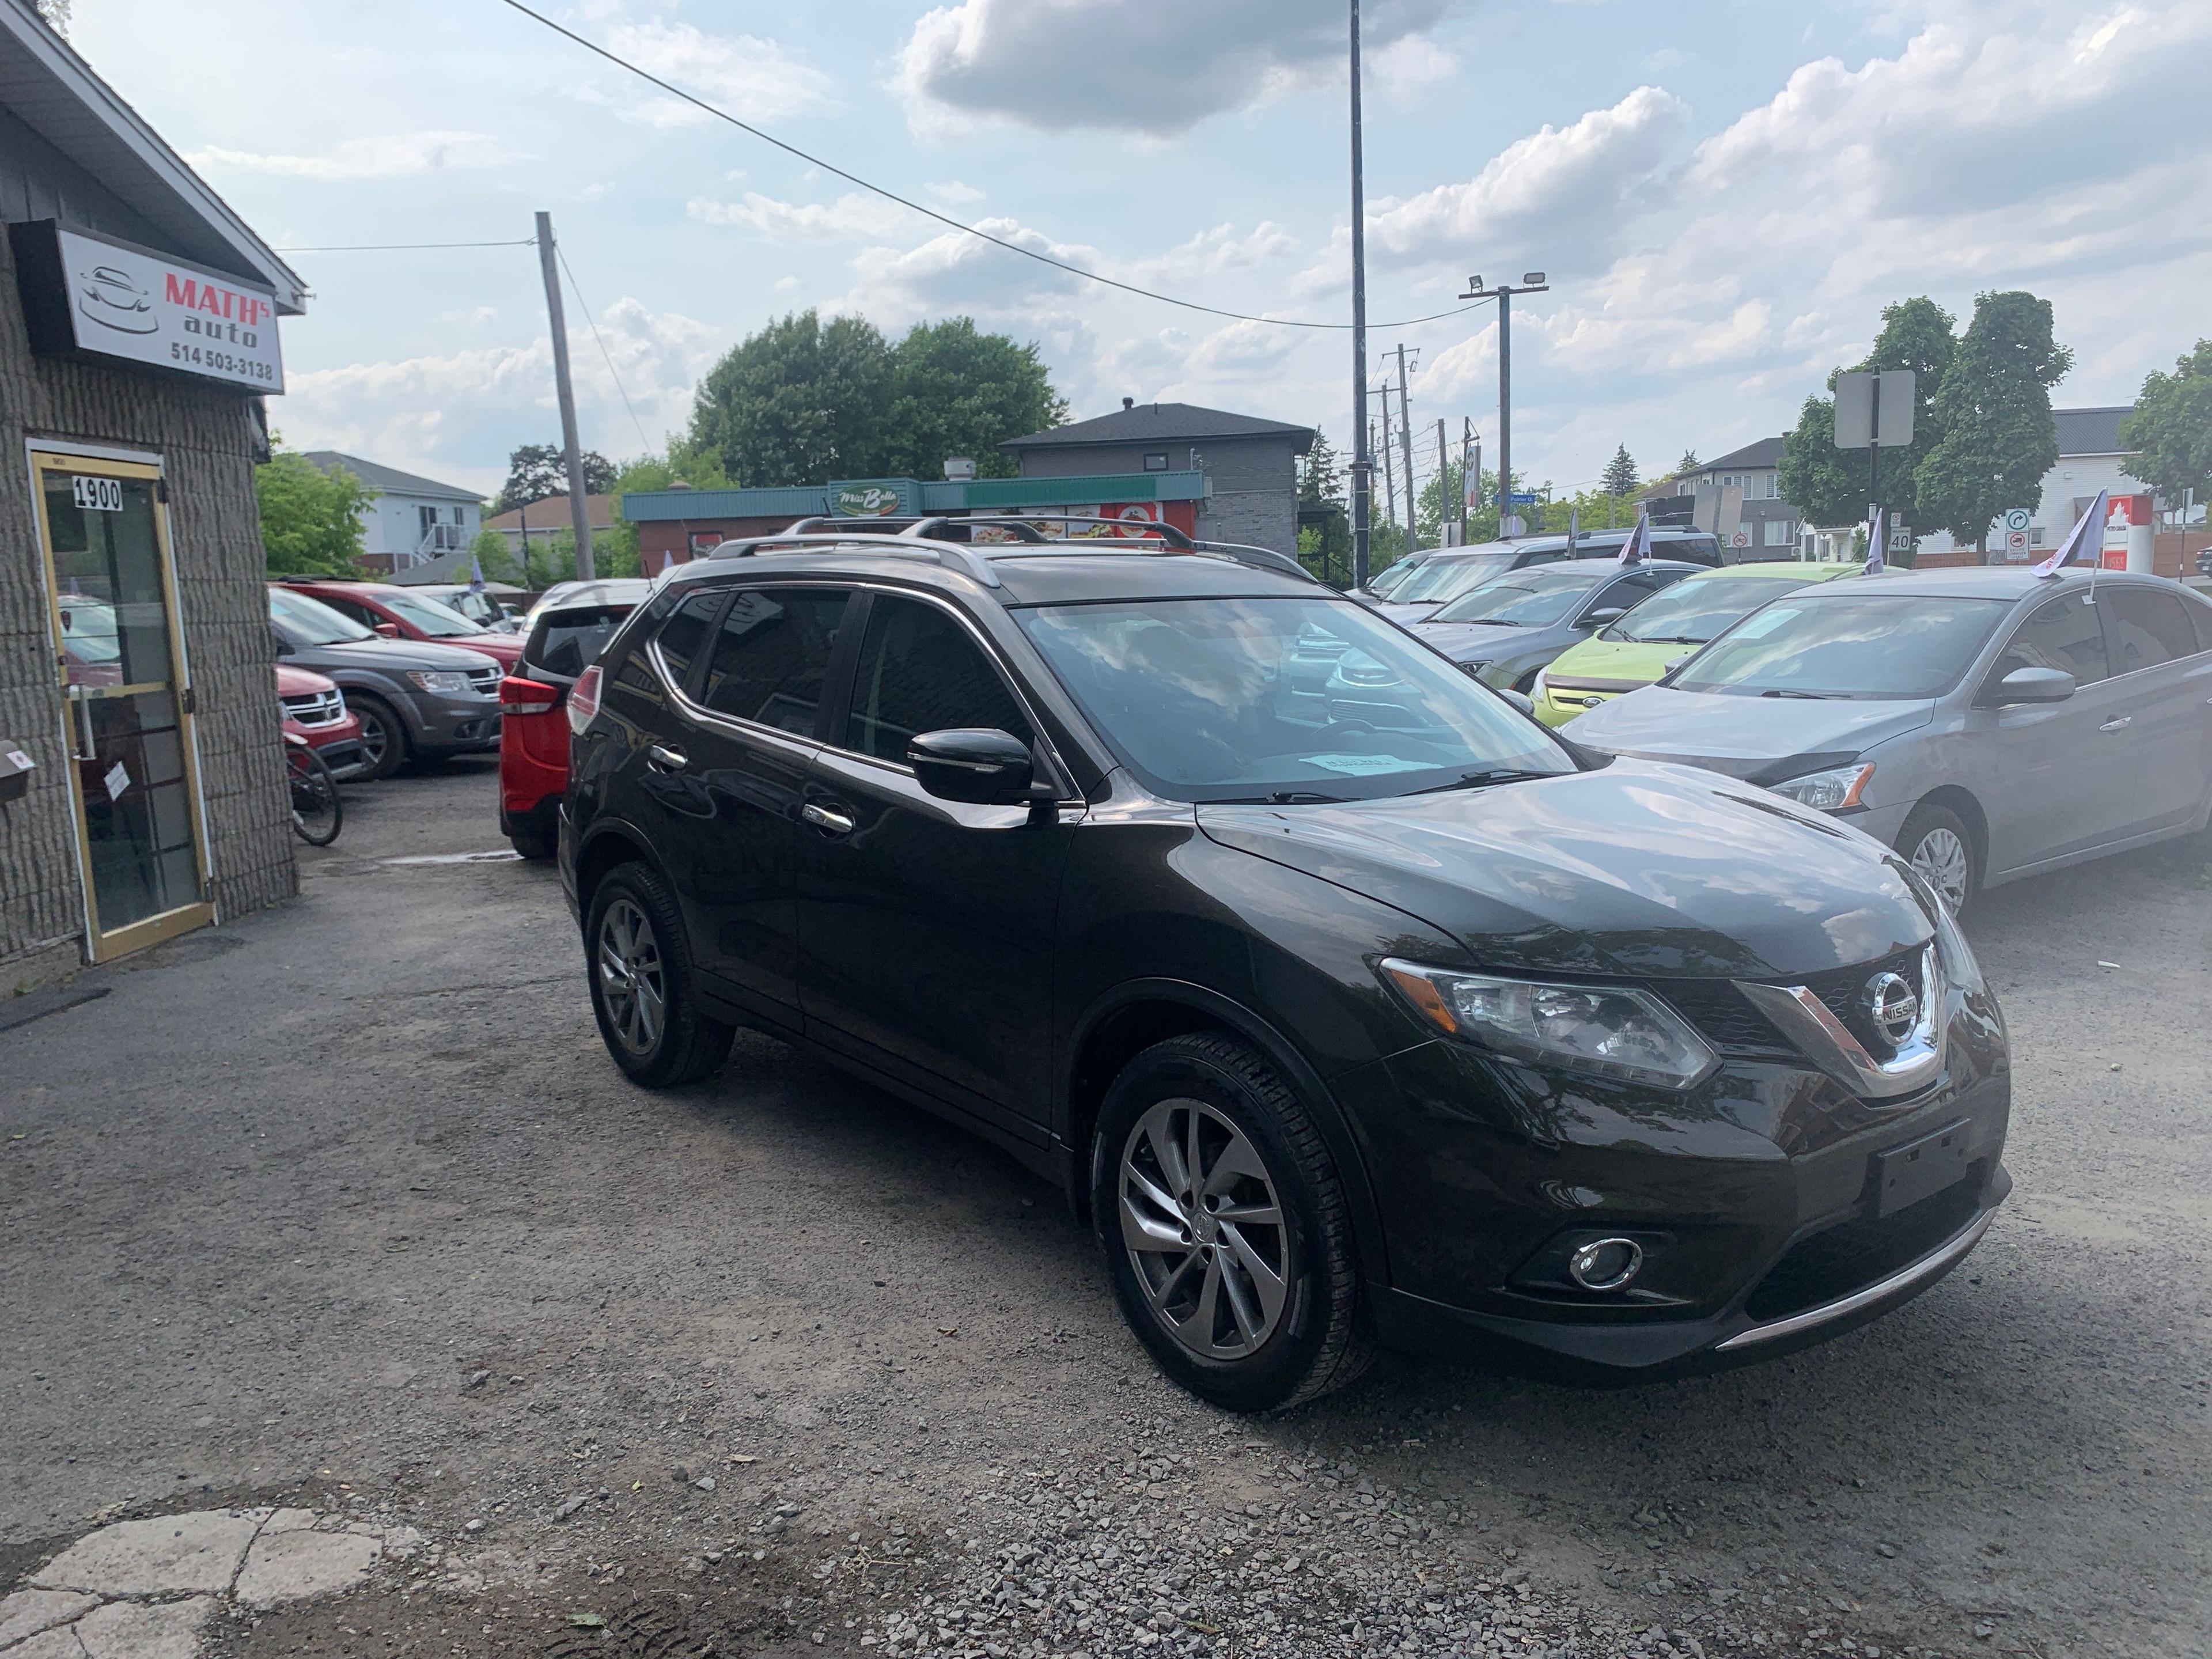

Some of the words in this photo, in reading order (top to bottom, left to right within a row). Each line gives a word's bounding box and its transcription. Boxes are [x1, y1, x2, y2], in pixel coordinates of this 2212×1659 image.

[184, 315, 257, 348] auto
[171, 342, 201, 364] 514
[206, 350, 272, 381] 503-3138
[75, 478, 119, 509] 1900
[839, 492, 864, 503] Miss
[862, 488, 896, 509] Bella
[1892, 536, 1908, 548] 40
[1884, 1001, 1916, 1021] NISSAN
